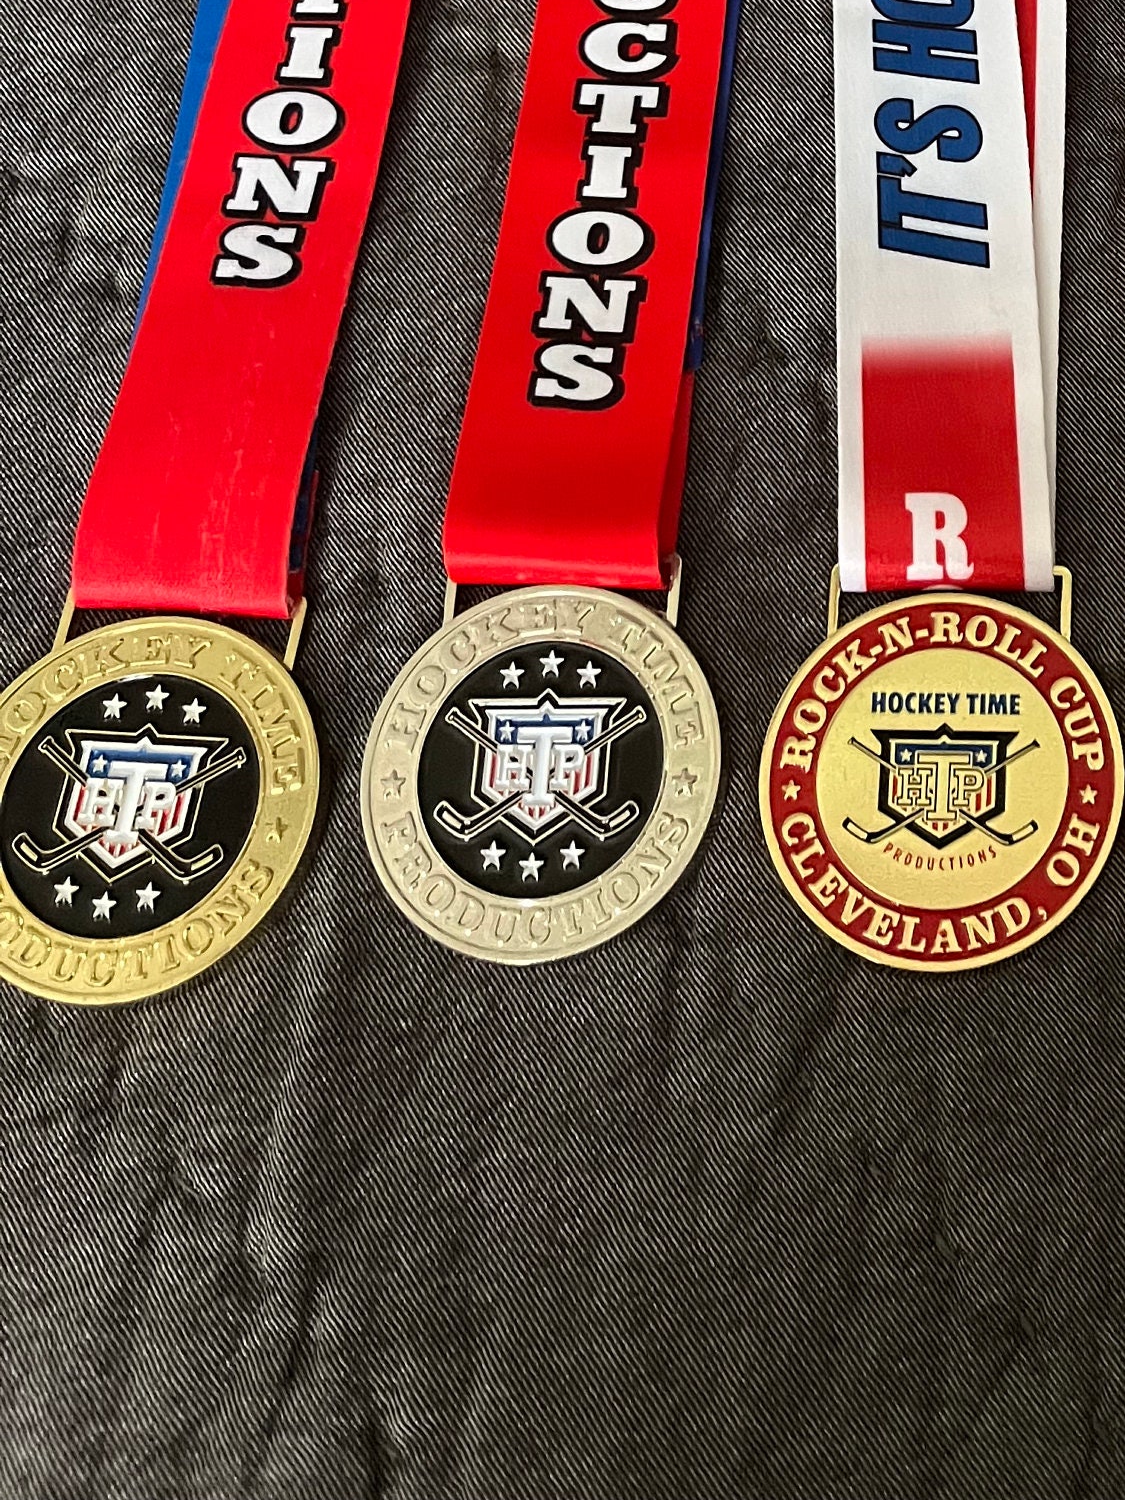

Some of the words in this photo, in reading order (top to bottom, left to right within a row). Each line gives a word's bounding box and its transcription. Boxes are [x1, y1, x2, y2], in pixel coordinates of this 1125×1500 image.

[874, 97, 992, 269] IT'S
[219, 648, 305, 796] TIME
[386, 598, 597, 754] HOCKEY
[608, 615, 706, 749] TIME
[781, 610, 1048, 773] ROCK-N-ROLL
[1050, 675, 1105, 772] CUP
[871, 691, 960, 717] HOCKEY
[966, 691, 1022, 717] TIME
[382, 810, 691, 946] PRODUCTIONS
[780, 811, 1050, 955] CLEVELAND,
[1047, 812, 1101, 888] OH
[883, 840, 998, 872] PRODUCTIONS
